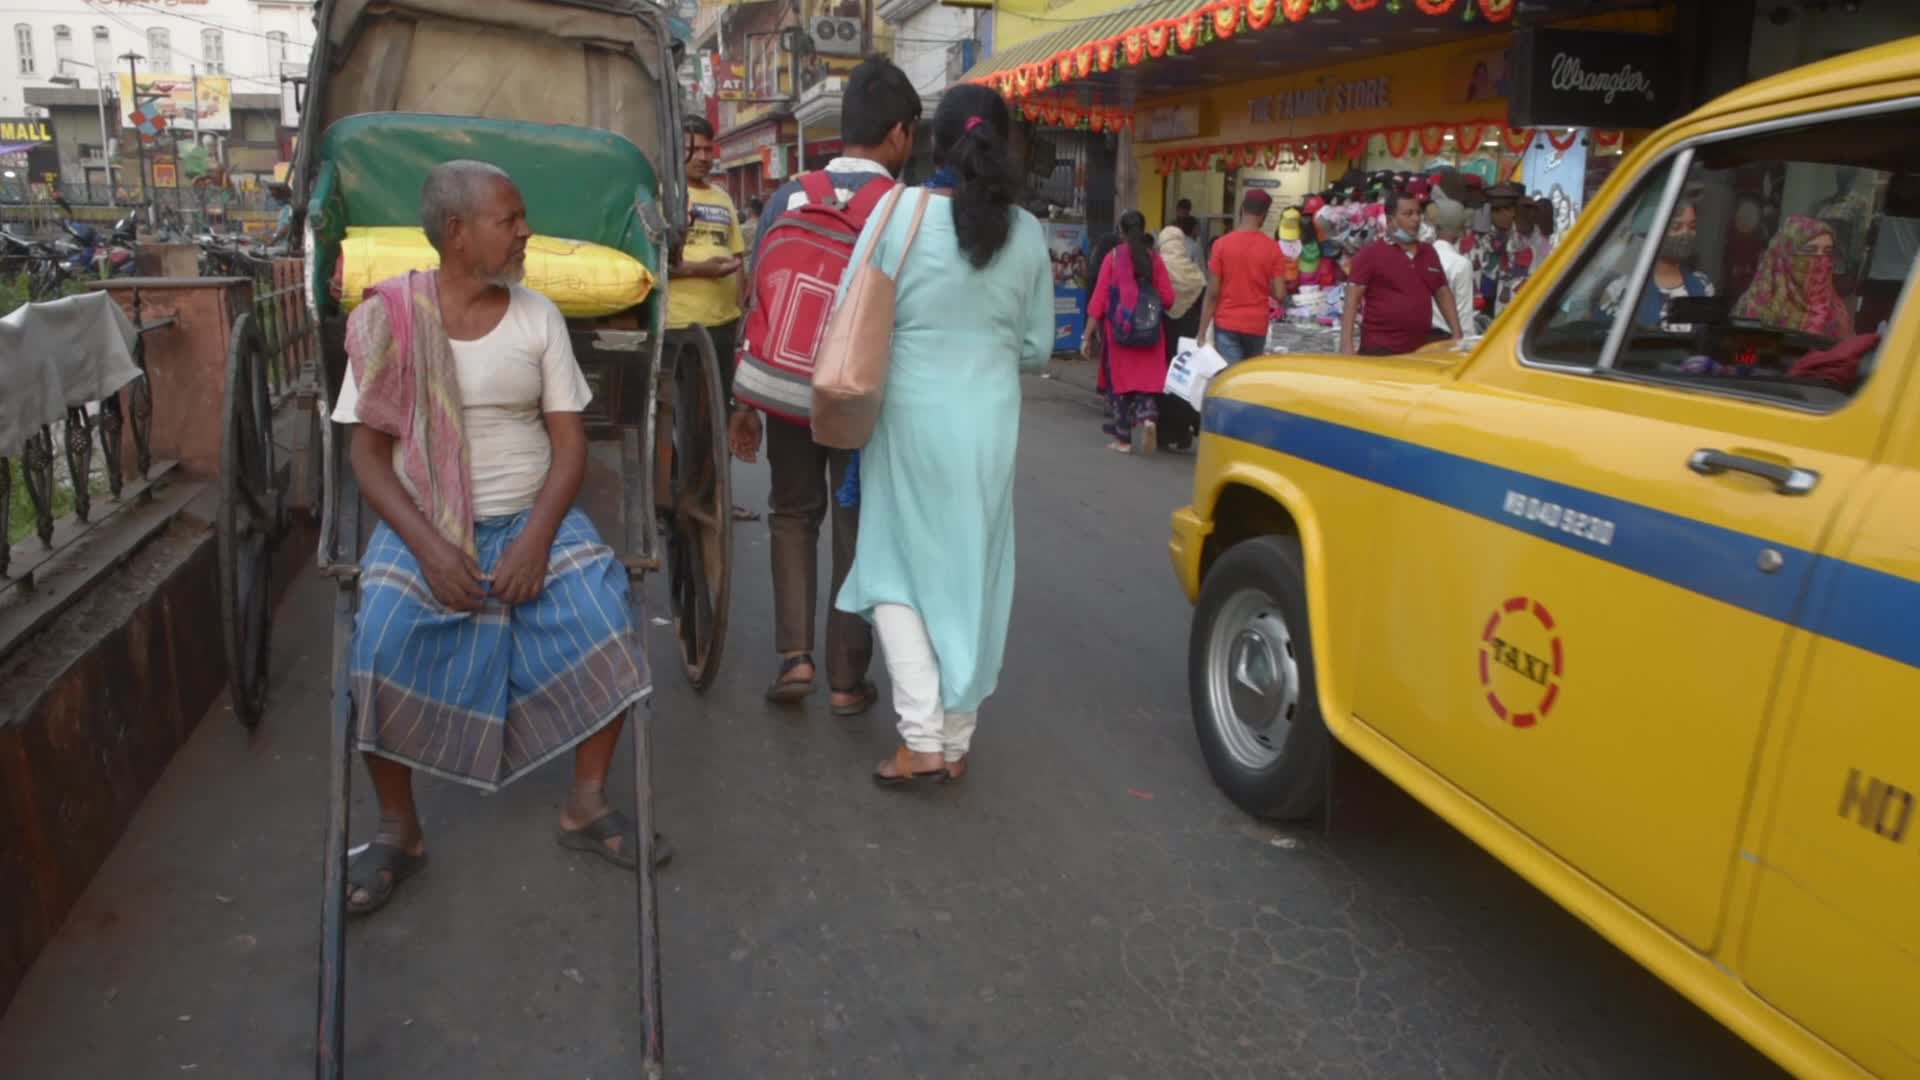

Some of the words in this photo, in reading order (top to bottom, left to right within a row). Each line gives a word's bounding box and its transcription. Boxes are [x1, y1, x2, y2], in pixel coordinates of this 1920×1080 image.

[723, 79, 752, 90] AT
[1335, 77, 1392, 113] STORE
[1551, 52, 1651, 104] Wrangler
[0, 122, 52, 141] MALL
[1493, 637, 1552, 686] TAXI
